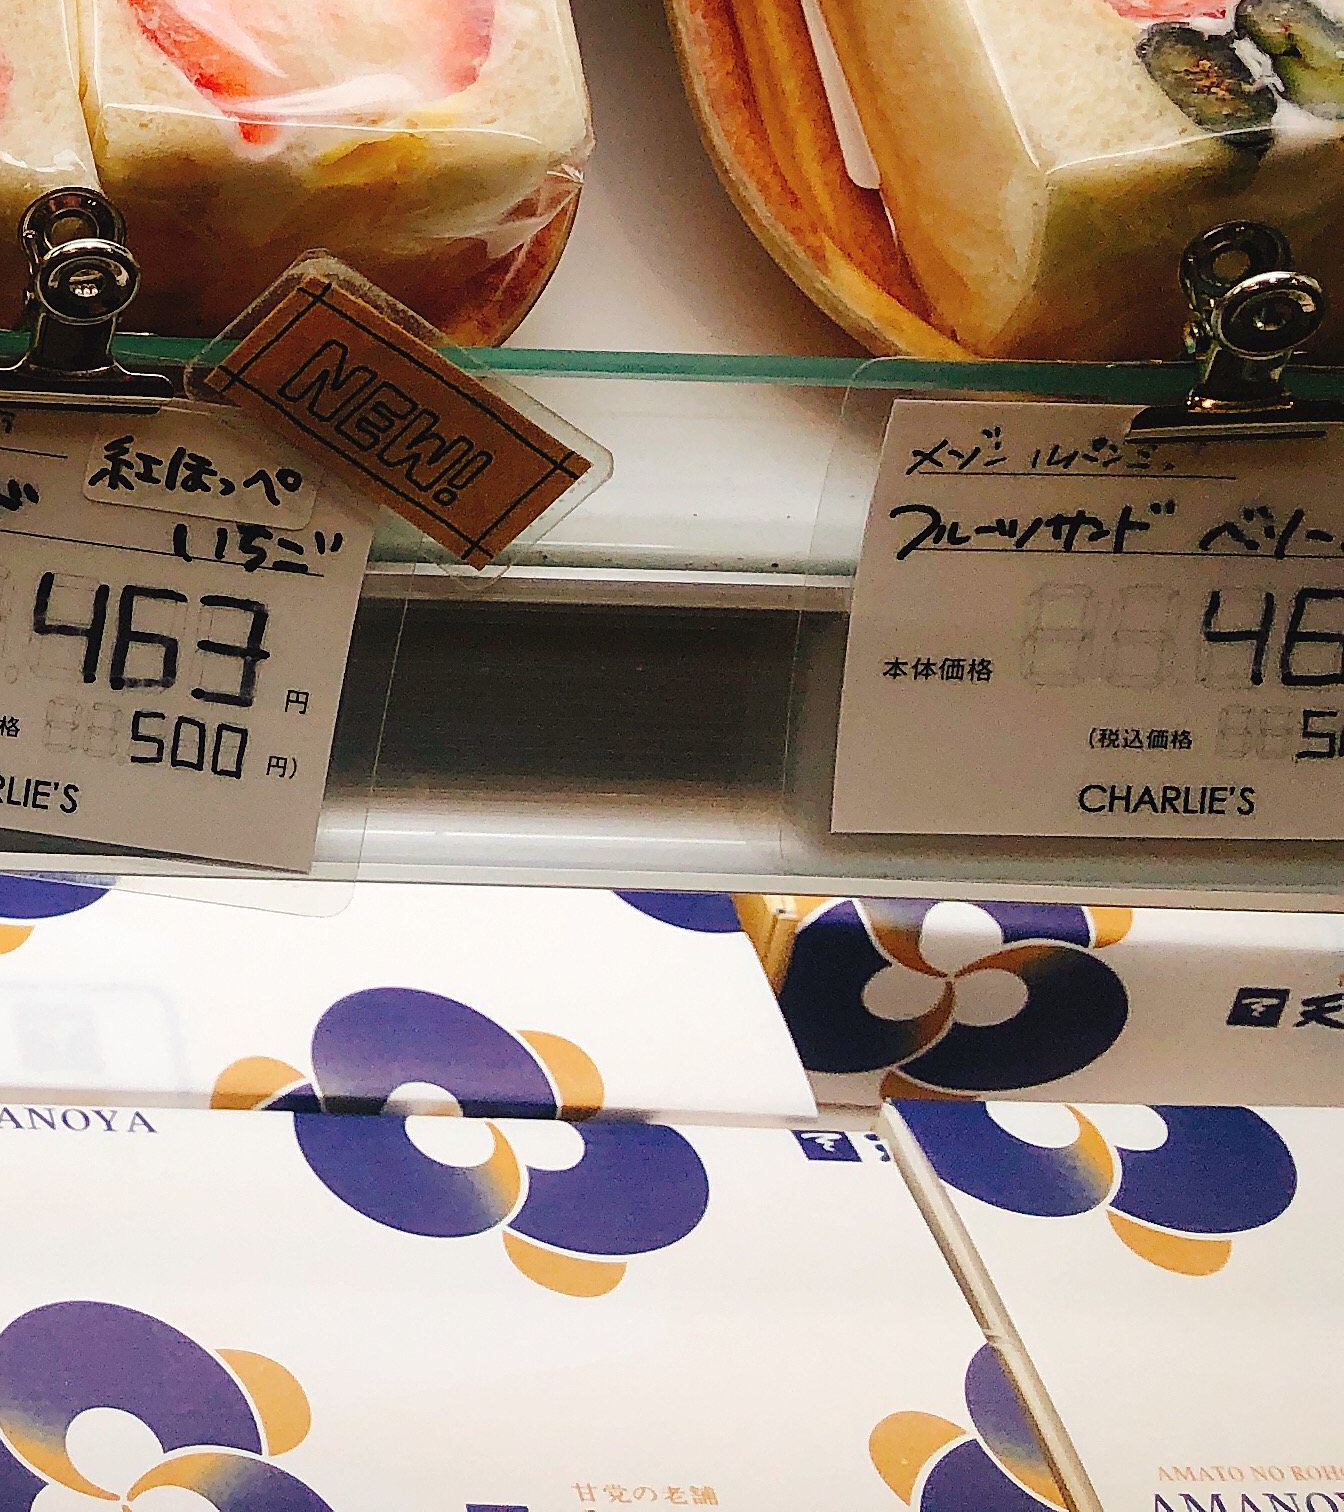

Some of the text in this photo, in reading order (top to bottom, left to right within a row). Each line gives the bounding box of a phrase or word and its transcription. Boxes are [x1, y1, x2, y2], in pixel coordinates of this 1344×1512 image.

[278, 338, 493, 507] NEW!
[87, 434, 304, 506] 紅ほっぺ
[172, 523, 345, 571] いちご
[889, 499, 1344, 560] フルーツサンド ベリー
[33, 570, 271, 708] 463
[283, 690, 310, 715] 円
[882, 587, 1344, 686] 本体価格 46
[130, 710, 248, 780] 500
[265, 754, 299, 781] 円)
[1088, 709, 1344, 760] (税込価格 5
[1078, 784, 1256, 816] CHARLIE'S
[571, 1482, 719, 1506] 甘党の老舗
[1158, 1466, 1344, 1482] AMATO NO ROH
